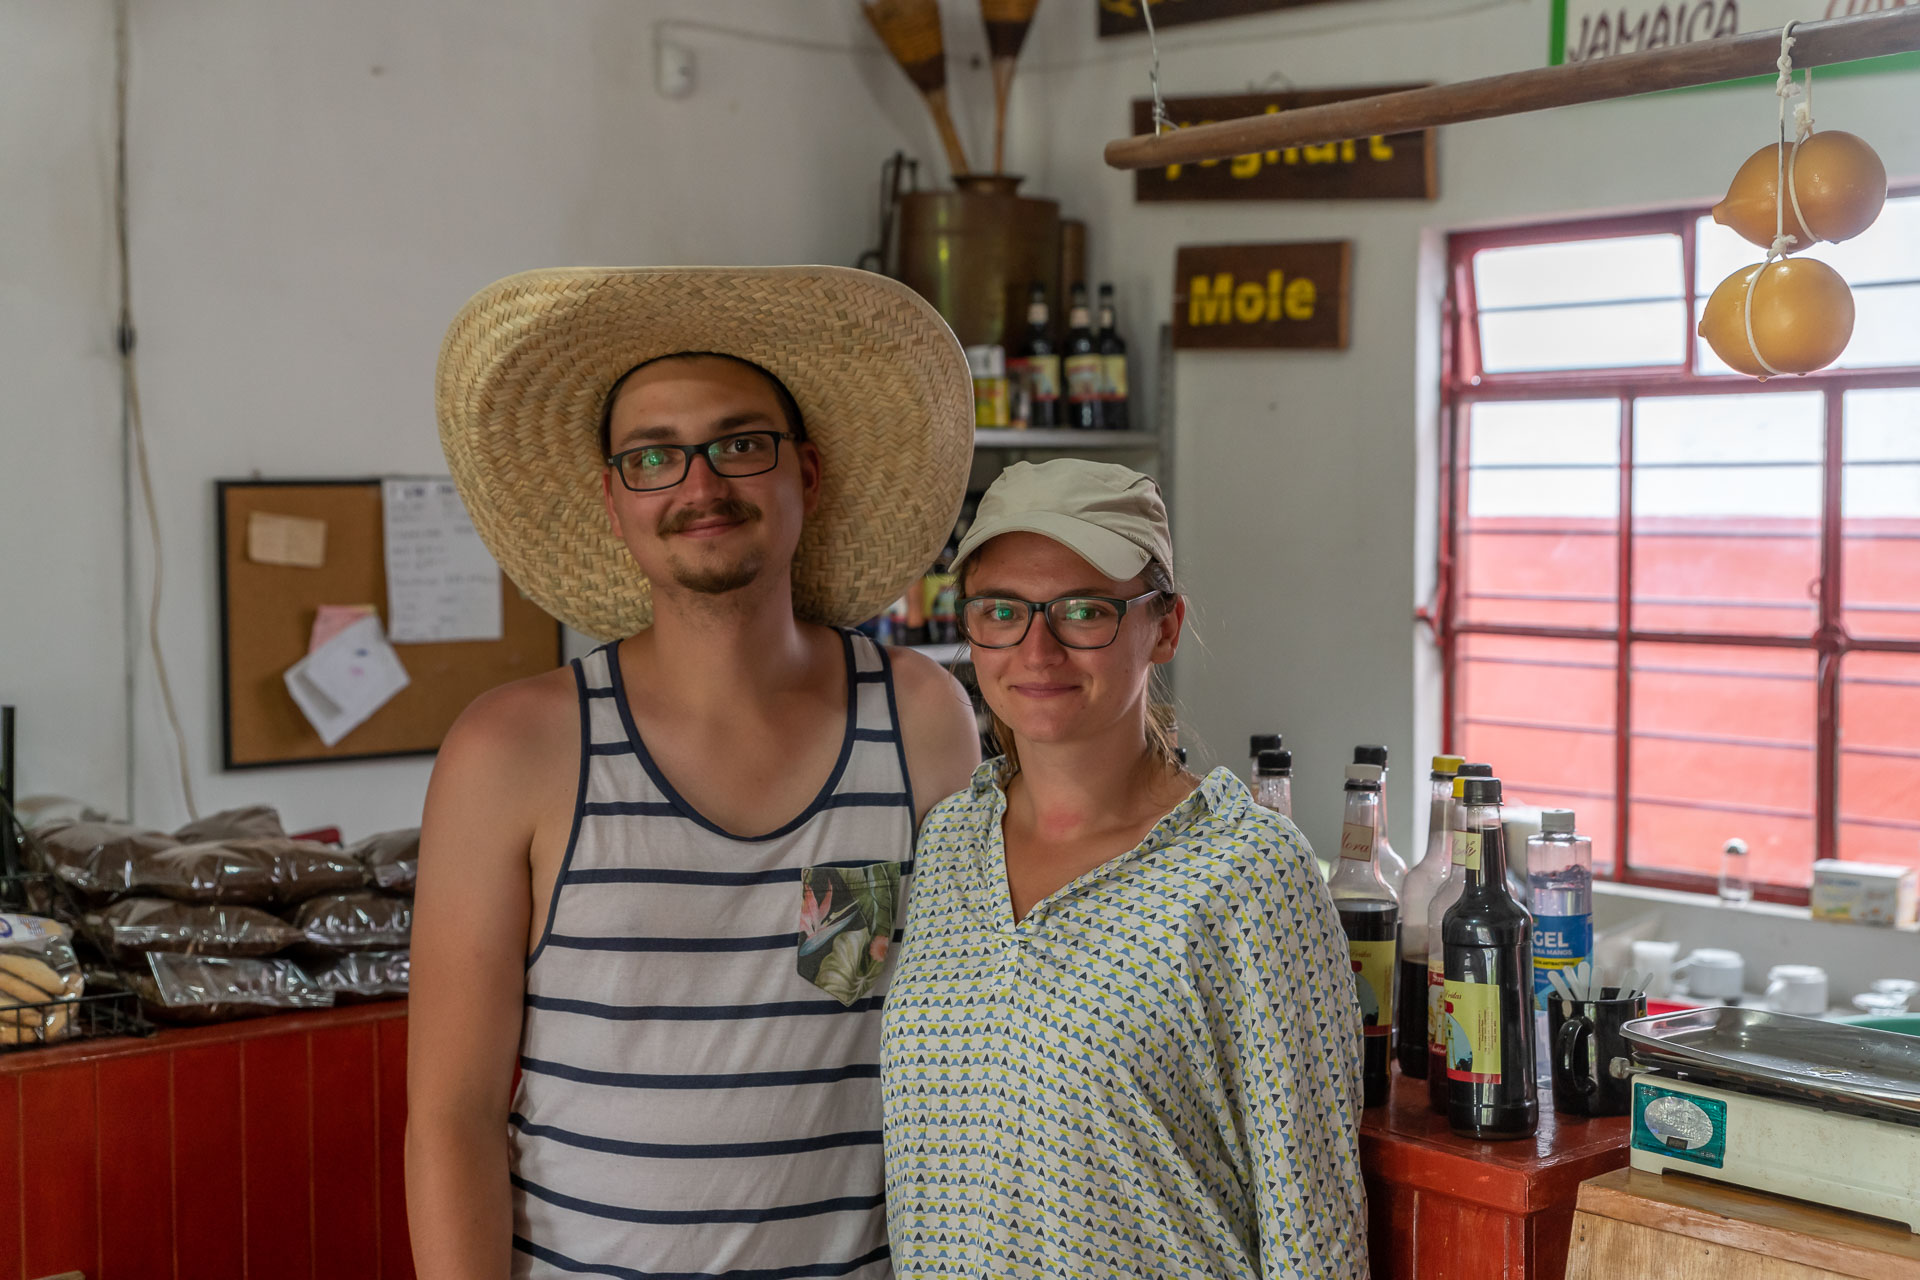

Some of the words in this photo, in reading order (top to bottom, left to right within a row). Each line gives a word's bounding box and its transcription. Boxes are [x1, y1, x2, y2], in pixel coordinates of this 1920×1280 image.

[1569, 0, 1738, 62] JAMAICA
[1188, 268, 1317, 326] Mole
[1533, 930, 1569, 948] GEL
